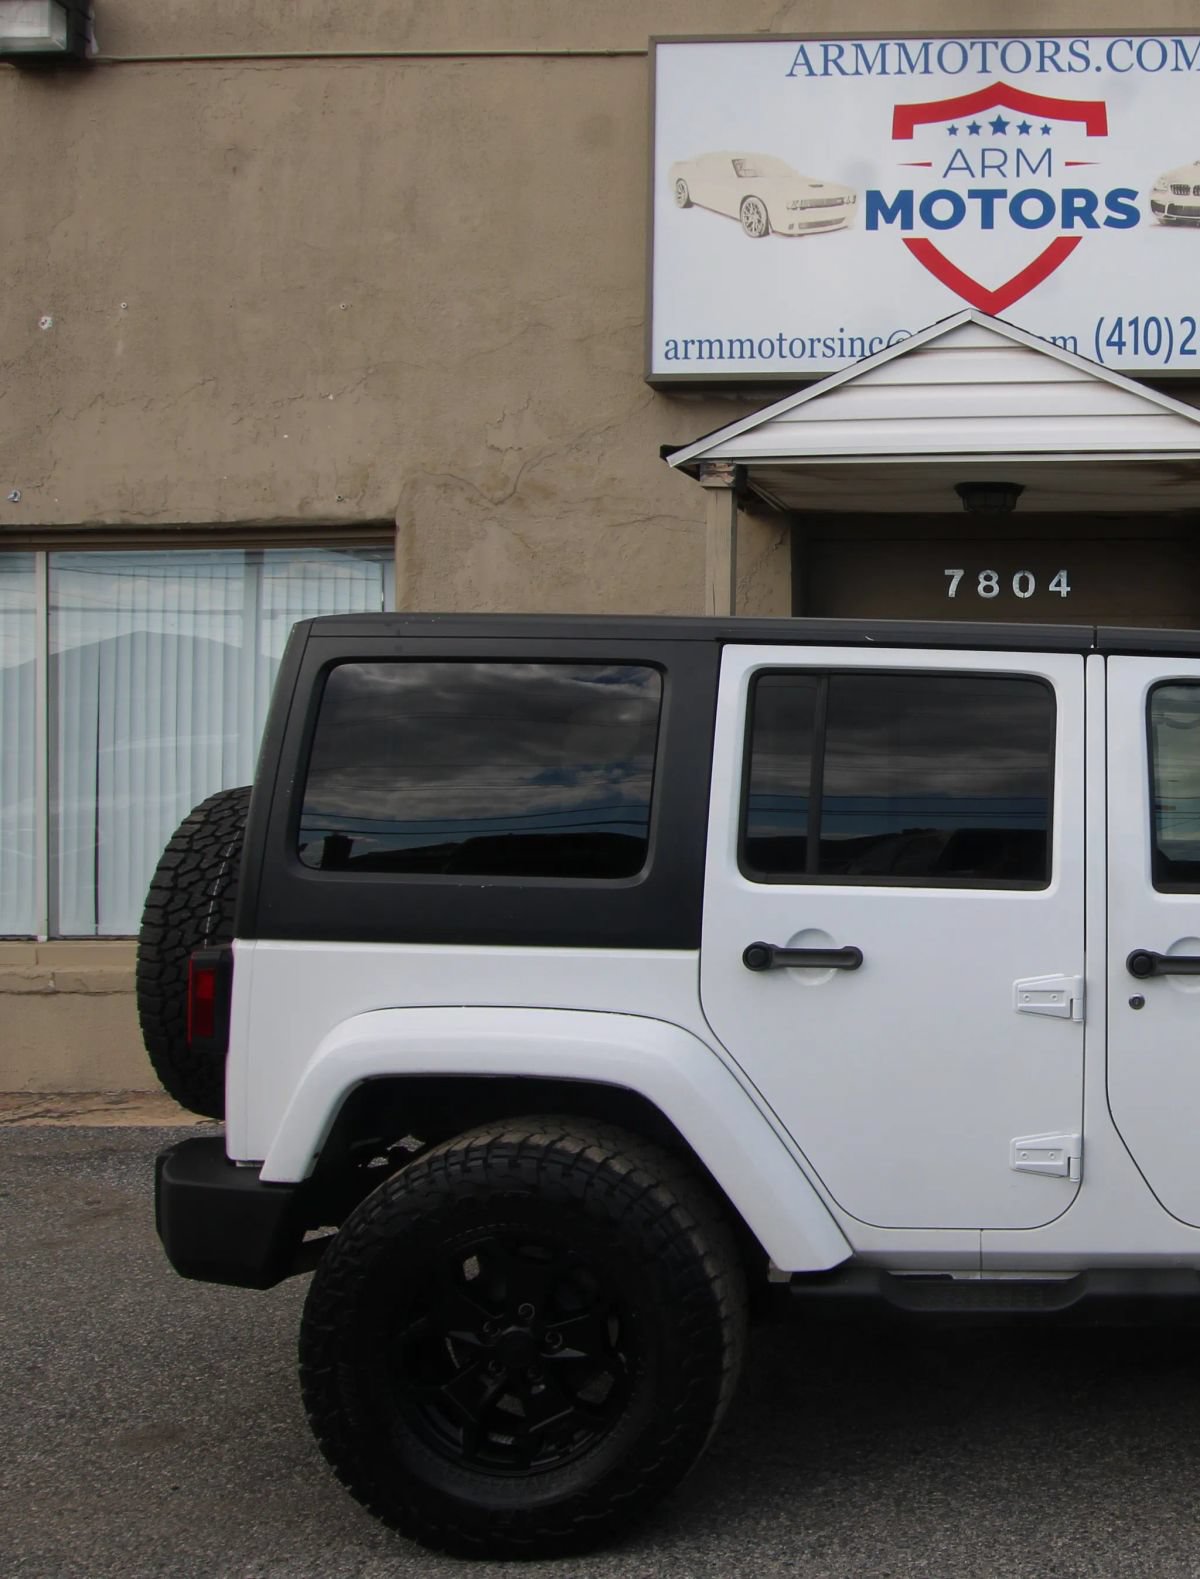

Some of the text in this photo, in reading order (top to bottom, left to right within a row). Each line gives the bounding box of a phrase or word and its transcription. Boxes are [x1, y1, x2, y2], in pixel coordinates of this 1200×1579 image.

[942, 147, 1053, 178] ARM
[865, 187, 1141, 231] MOTORS
[944, 569, 1071, 599] 7804
